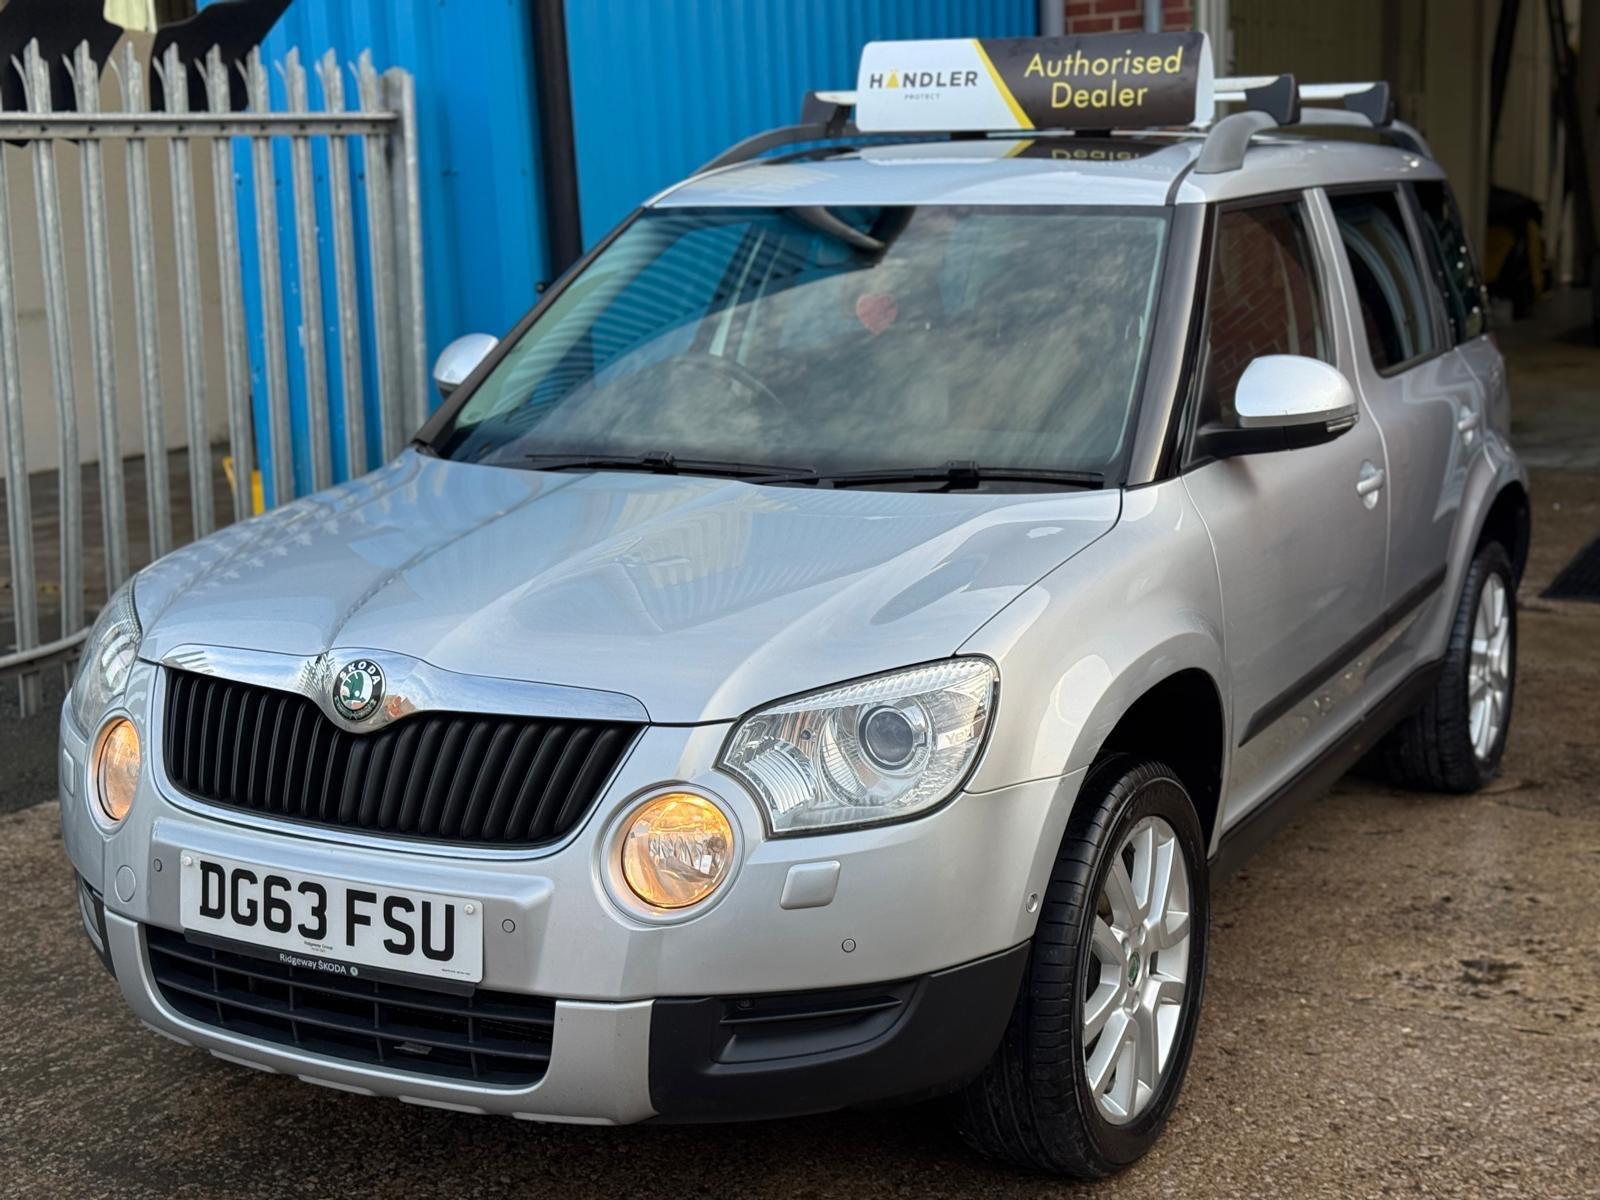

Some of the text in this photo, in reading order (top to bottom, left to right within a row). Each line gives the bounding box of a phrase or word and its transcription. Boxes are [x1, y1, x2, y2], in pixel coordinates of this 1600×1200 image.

[1024, 45, 1184, 78] Authorised
[1051, 79, 1148, 108] Dealer
[199, 860, 455, 962] DG63 FSU
[280, 953, 317, 969] Ridgeway
